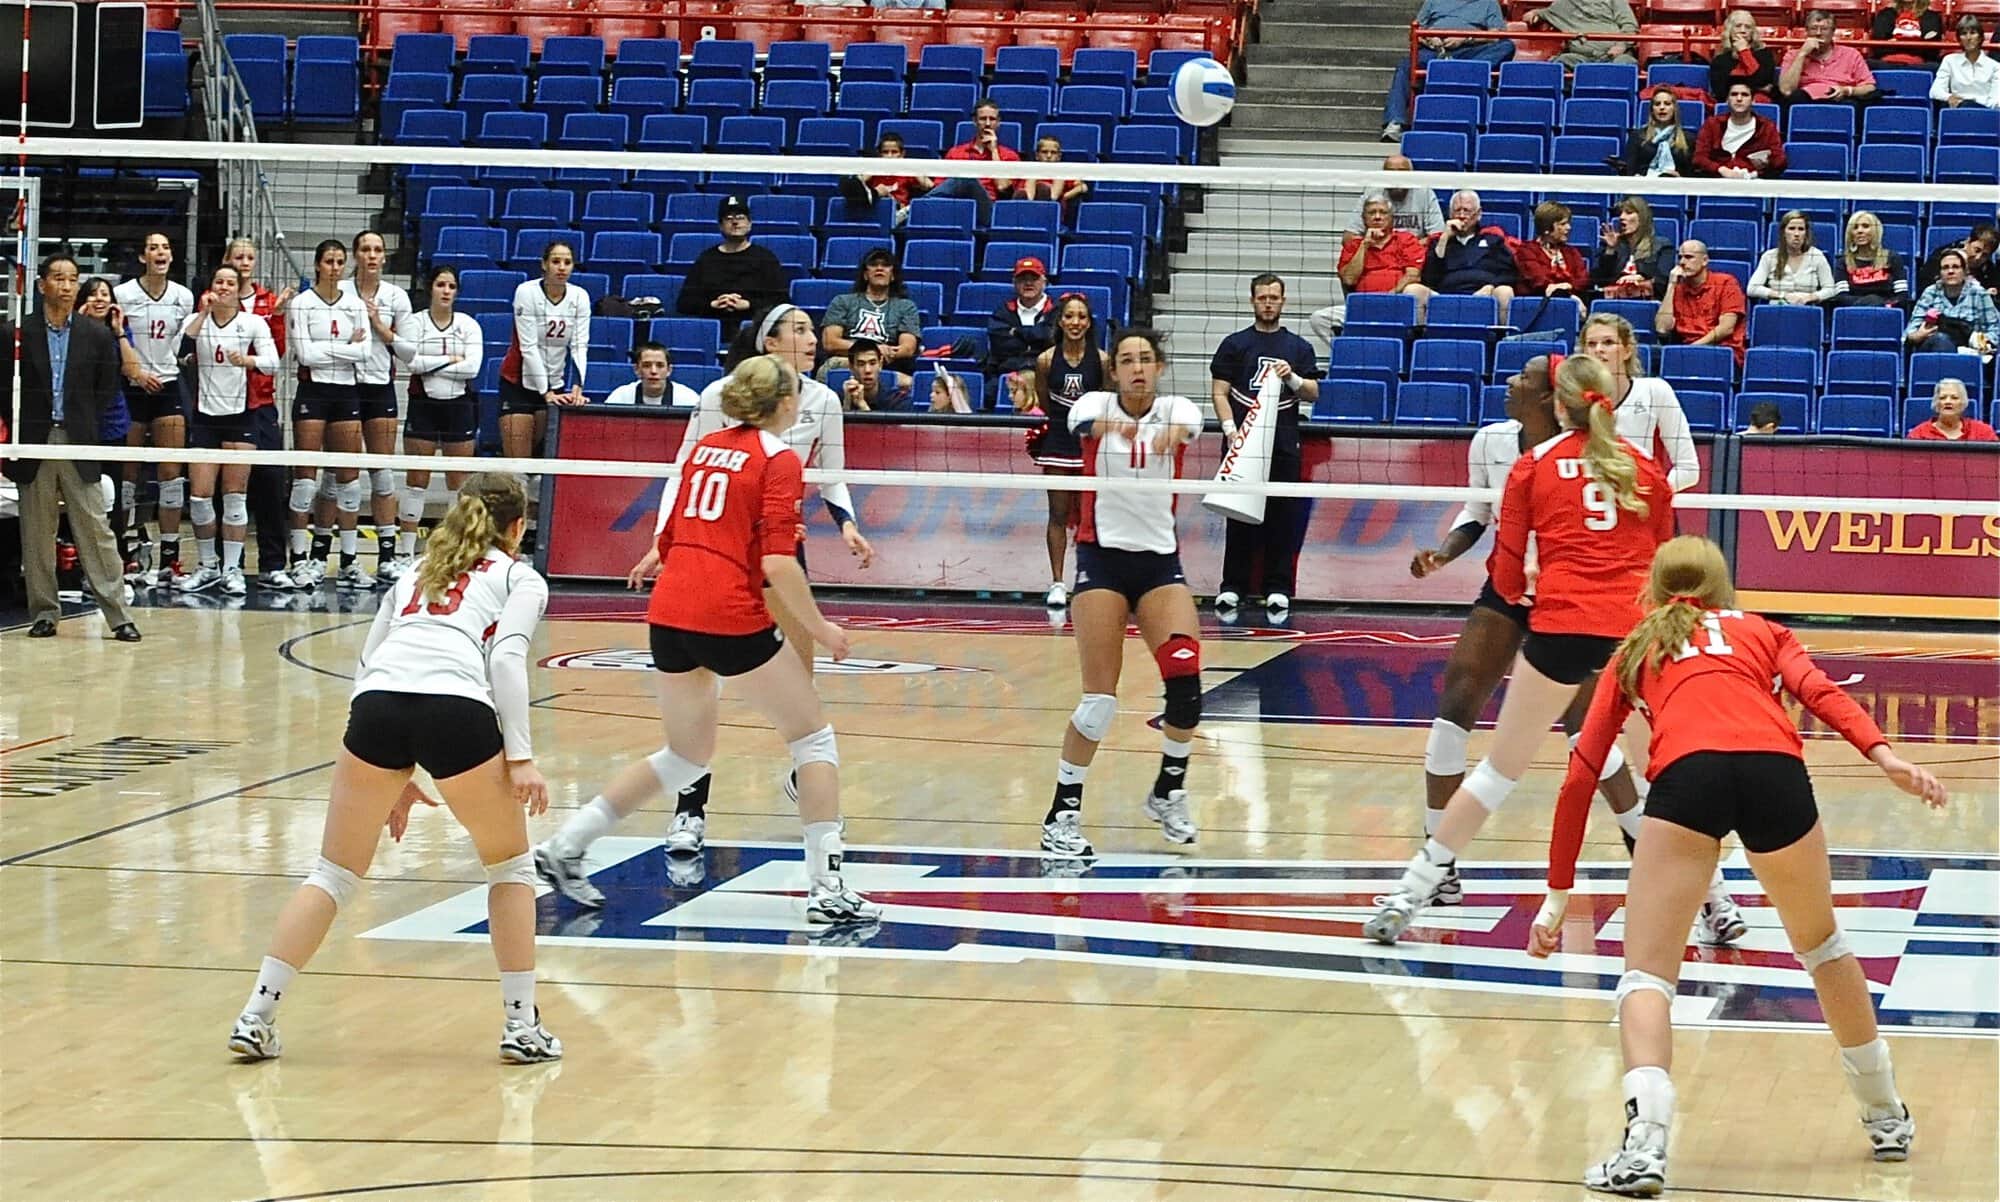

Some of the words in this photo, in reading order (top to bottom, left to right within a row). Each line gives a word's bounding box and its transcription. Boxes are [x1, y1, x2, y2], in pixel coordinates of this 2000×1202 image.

[150, 320, 166, 339] 12
[330, 319, 340, 338] 4
[546, 320, 566, 338] 22
[849, 308, 889, 343] A
[215, 344, 225, 363] 6
[1220, 395, 1261, 475] ARIZONA
[691, 445, 750, 472] UTAH
[1130, 440, 1146, 469] 11
[683, 469, 729, 521] 10
[1582, 481, 1618, 531] 9
